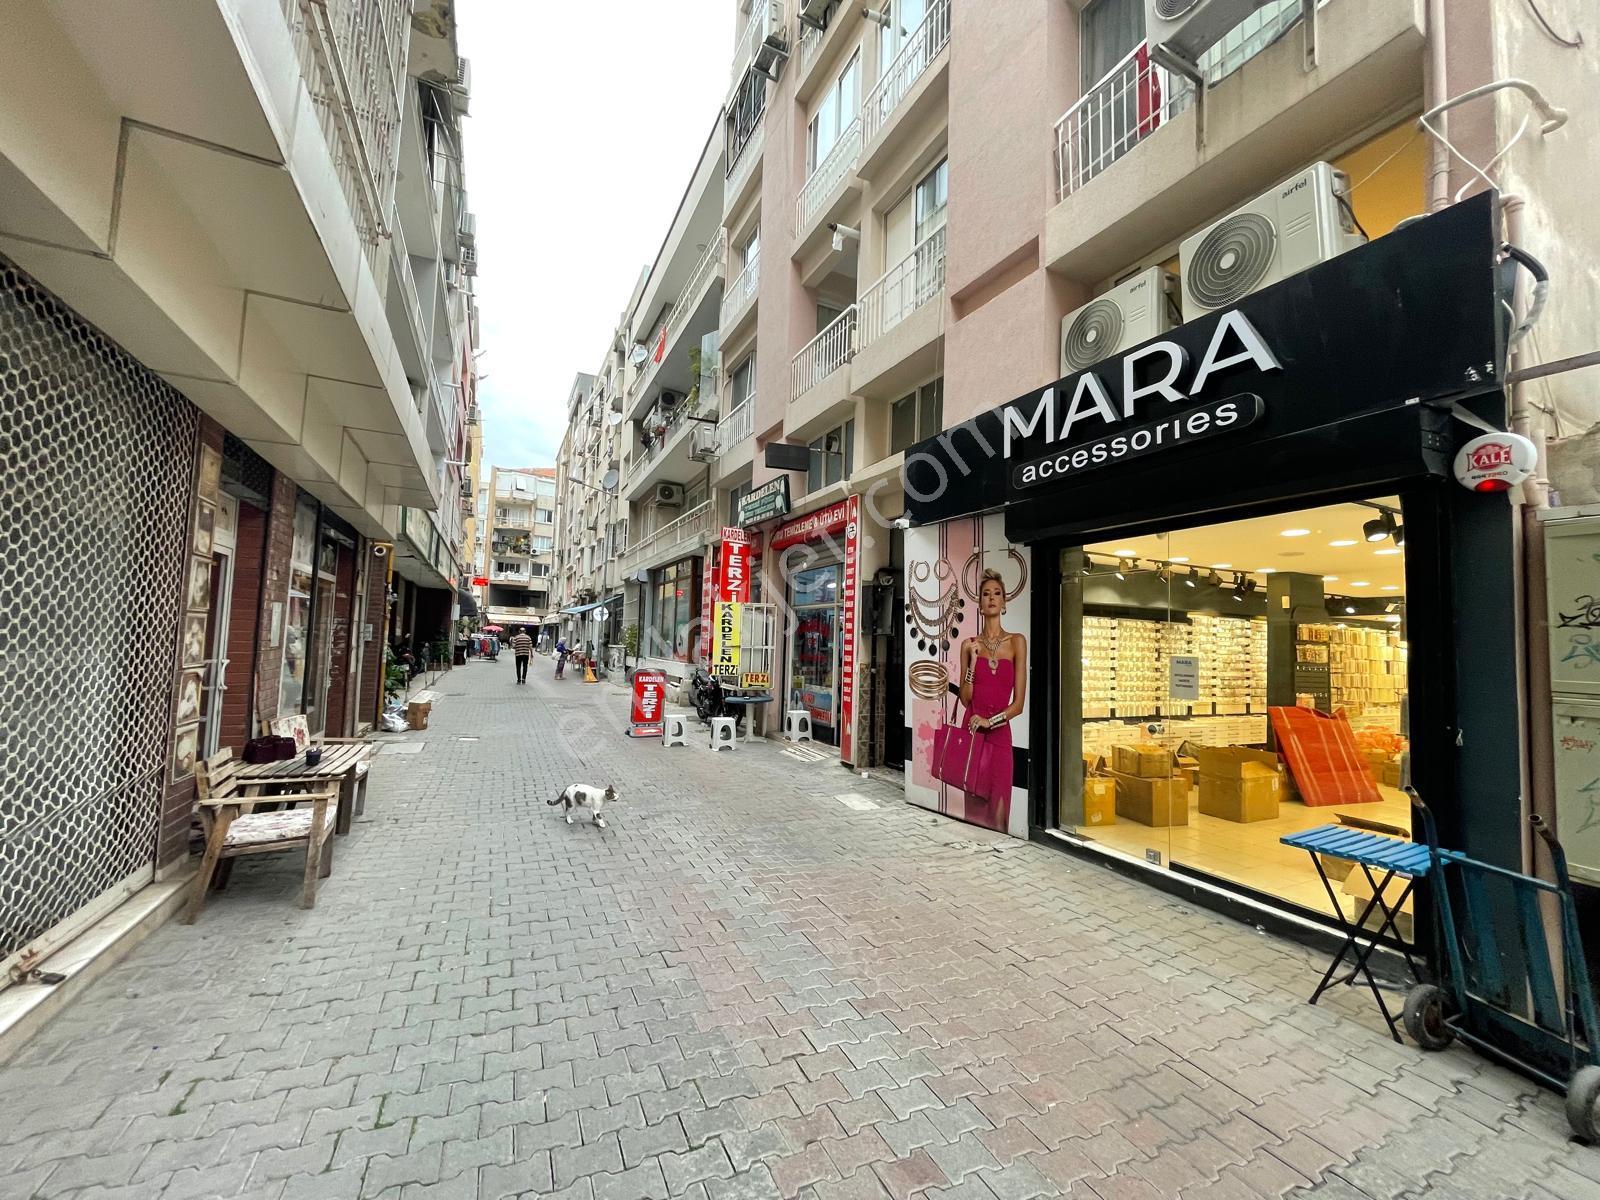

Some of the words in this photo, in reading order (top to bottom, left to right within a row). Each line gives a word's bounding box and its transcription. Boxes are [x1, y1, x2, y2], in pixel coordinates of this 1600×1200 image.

[1282, 178, 1308, 199] airfel
[1003, 309, 1283, 459] MARA
[1467, 446, 1512, 470] KALE
[722, 529, 751, 543] KARDELEN
[720, 603, 733, 663] KARDELEN
